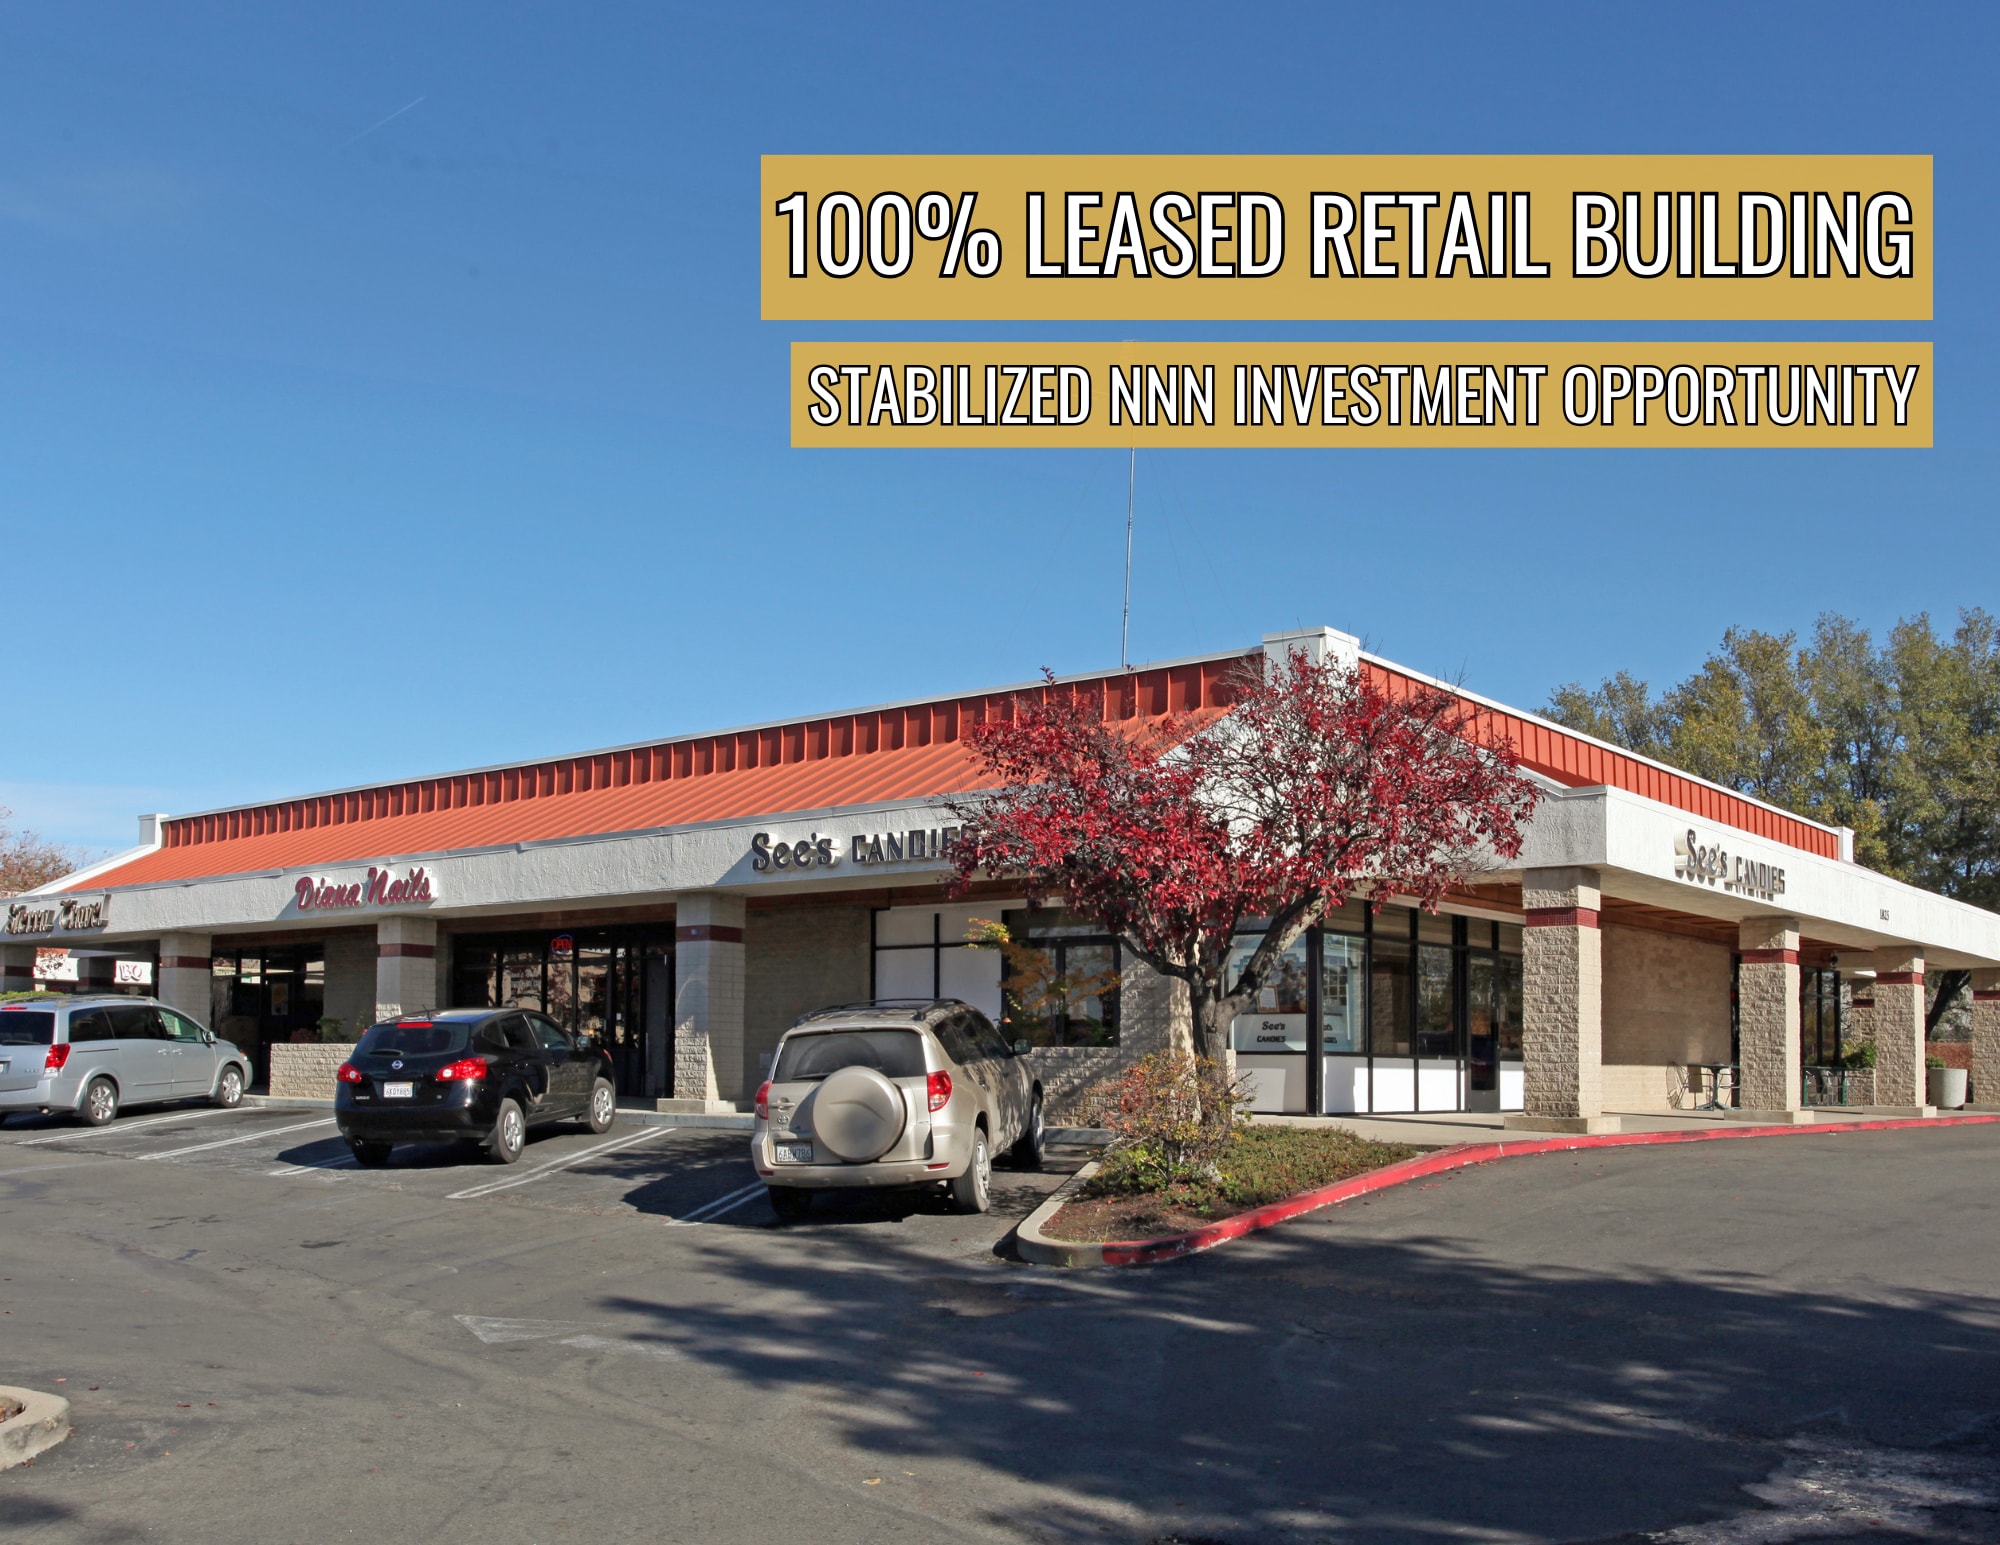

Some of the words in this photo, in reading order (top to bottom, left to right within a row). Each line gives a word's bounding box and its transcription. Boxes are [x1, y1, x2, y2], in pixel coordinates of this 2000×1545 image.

[751, 831, 835, 872] See's
[851, 826, 970, 863] CANDIE
[1685, 828, 1728, 879] See's
[1735, 855, 1785, 895] CANDIES
[294, 876, 362, 910] Diana
[367, 866, 433, 905] Nails
[551, 938, 572, 950] OPEN
[1256, 1035, 1287, 1043] CANDIES
[1261, 1021, 1286, 1031] See's
